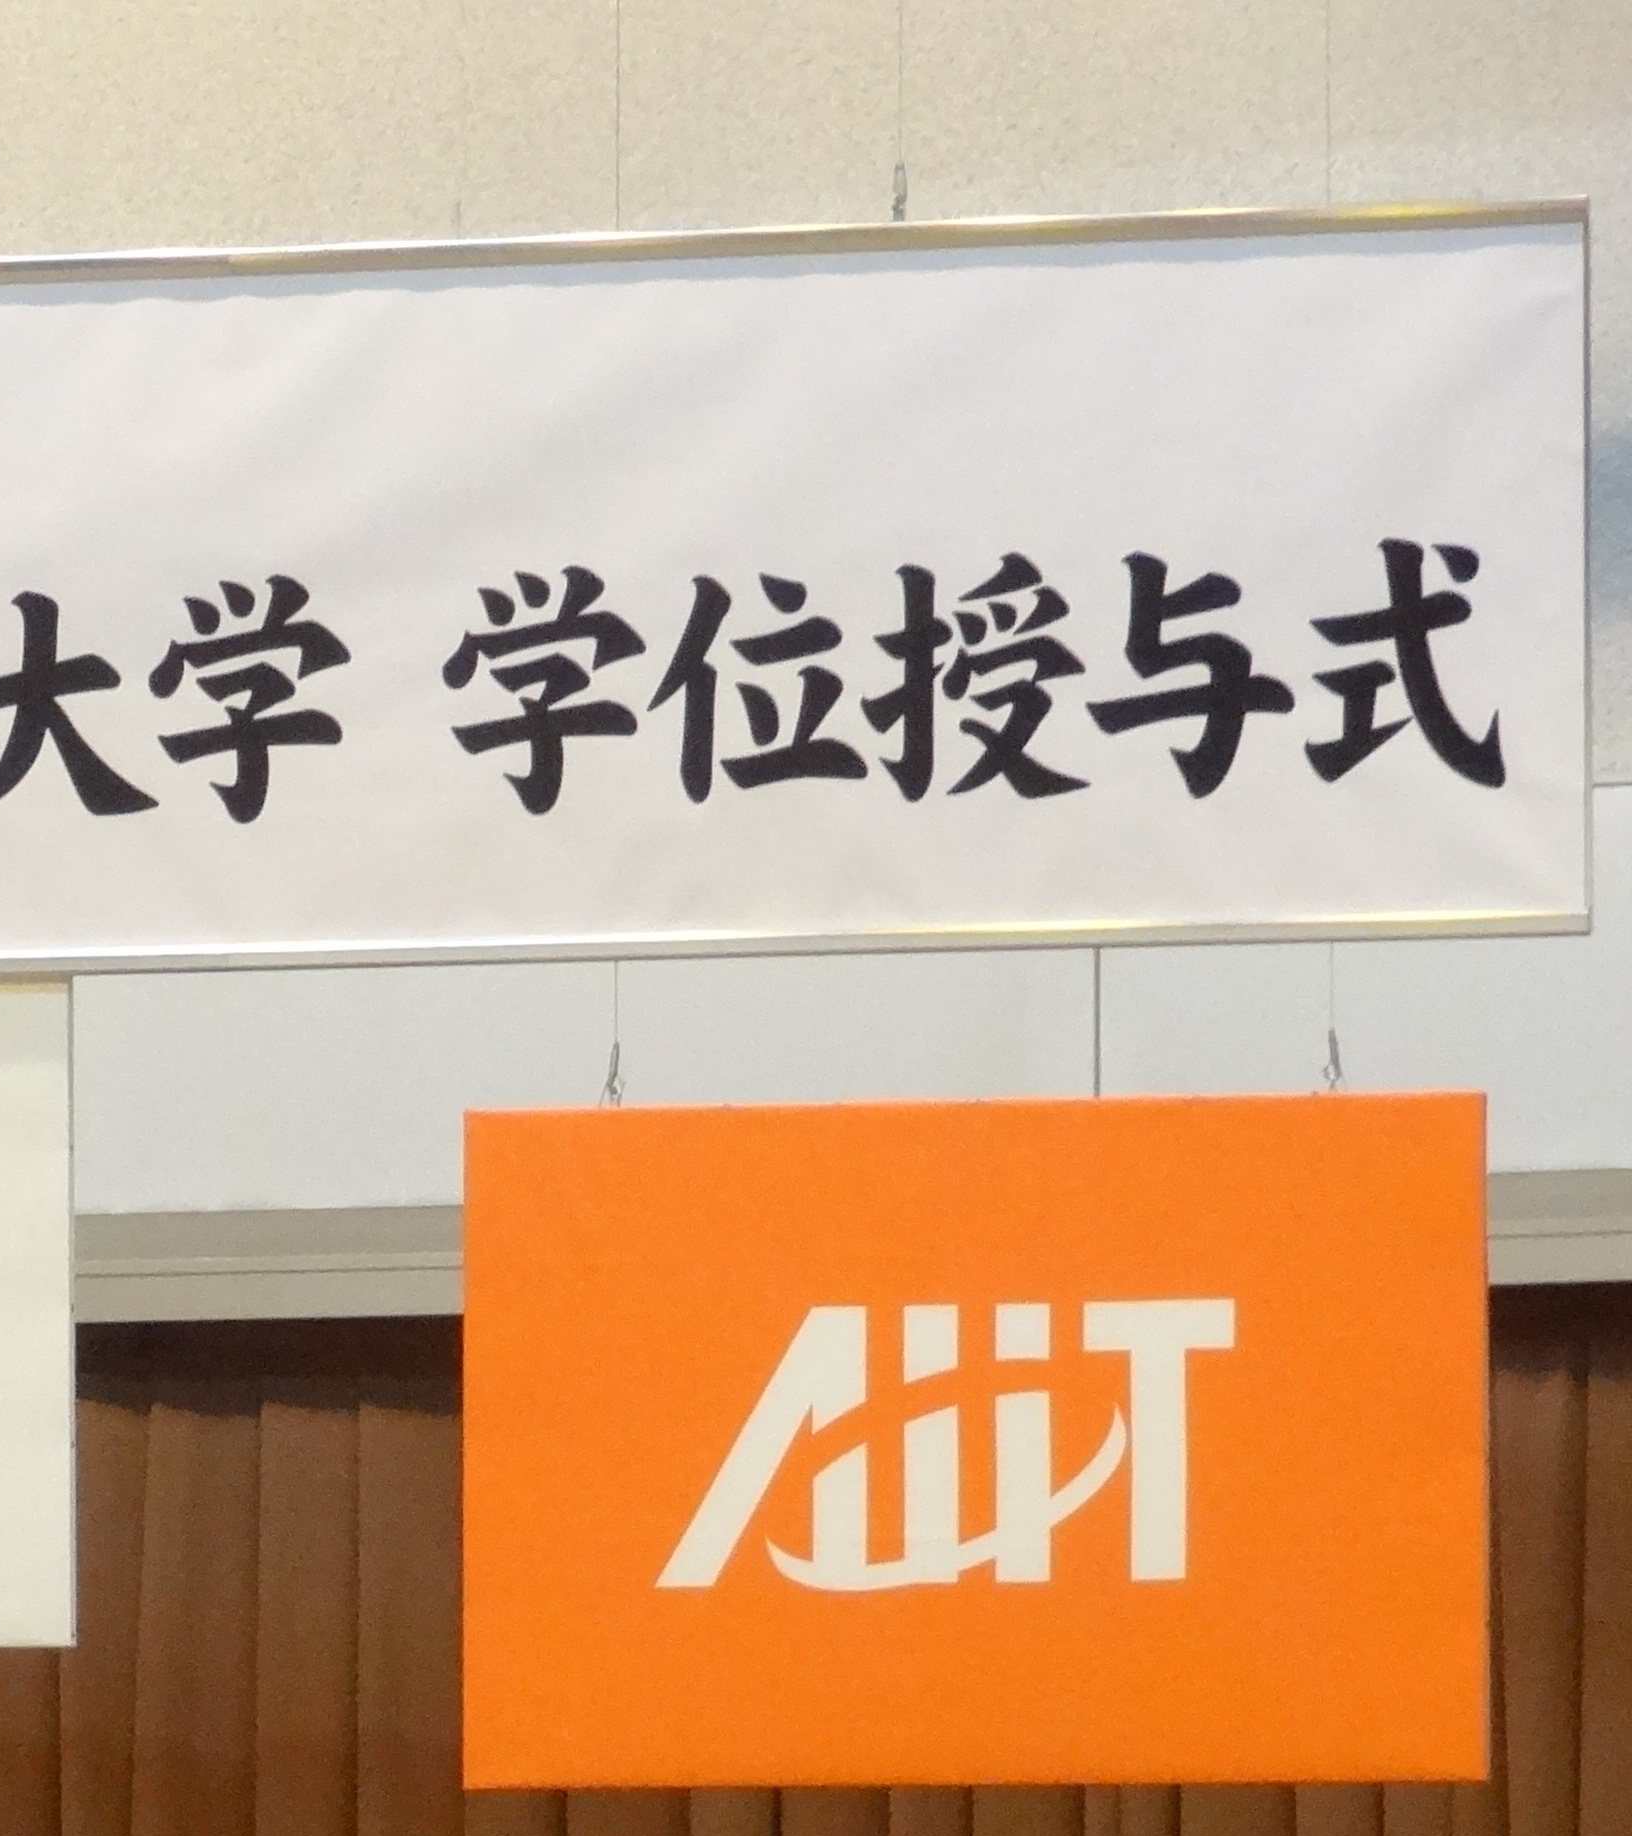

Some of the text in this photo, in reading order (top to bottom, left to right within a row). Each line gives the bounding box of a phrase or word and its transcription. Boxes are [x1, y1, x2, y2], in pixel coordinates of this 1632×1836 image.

[441, 537, 1508, 817] 学位授与式
